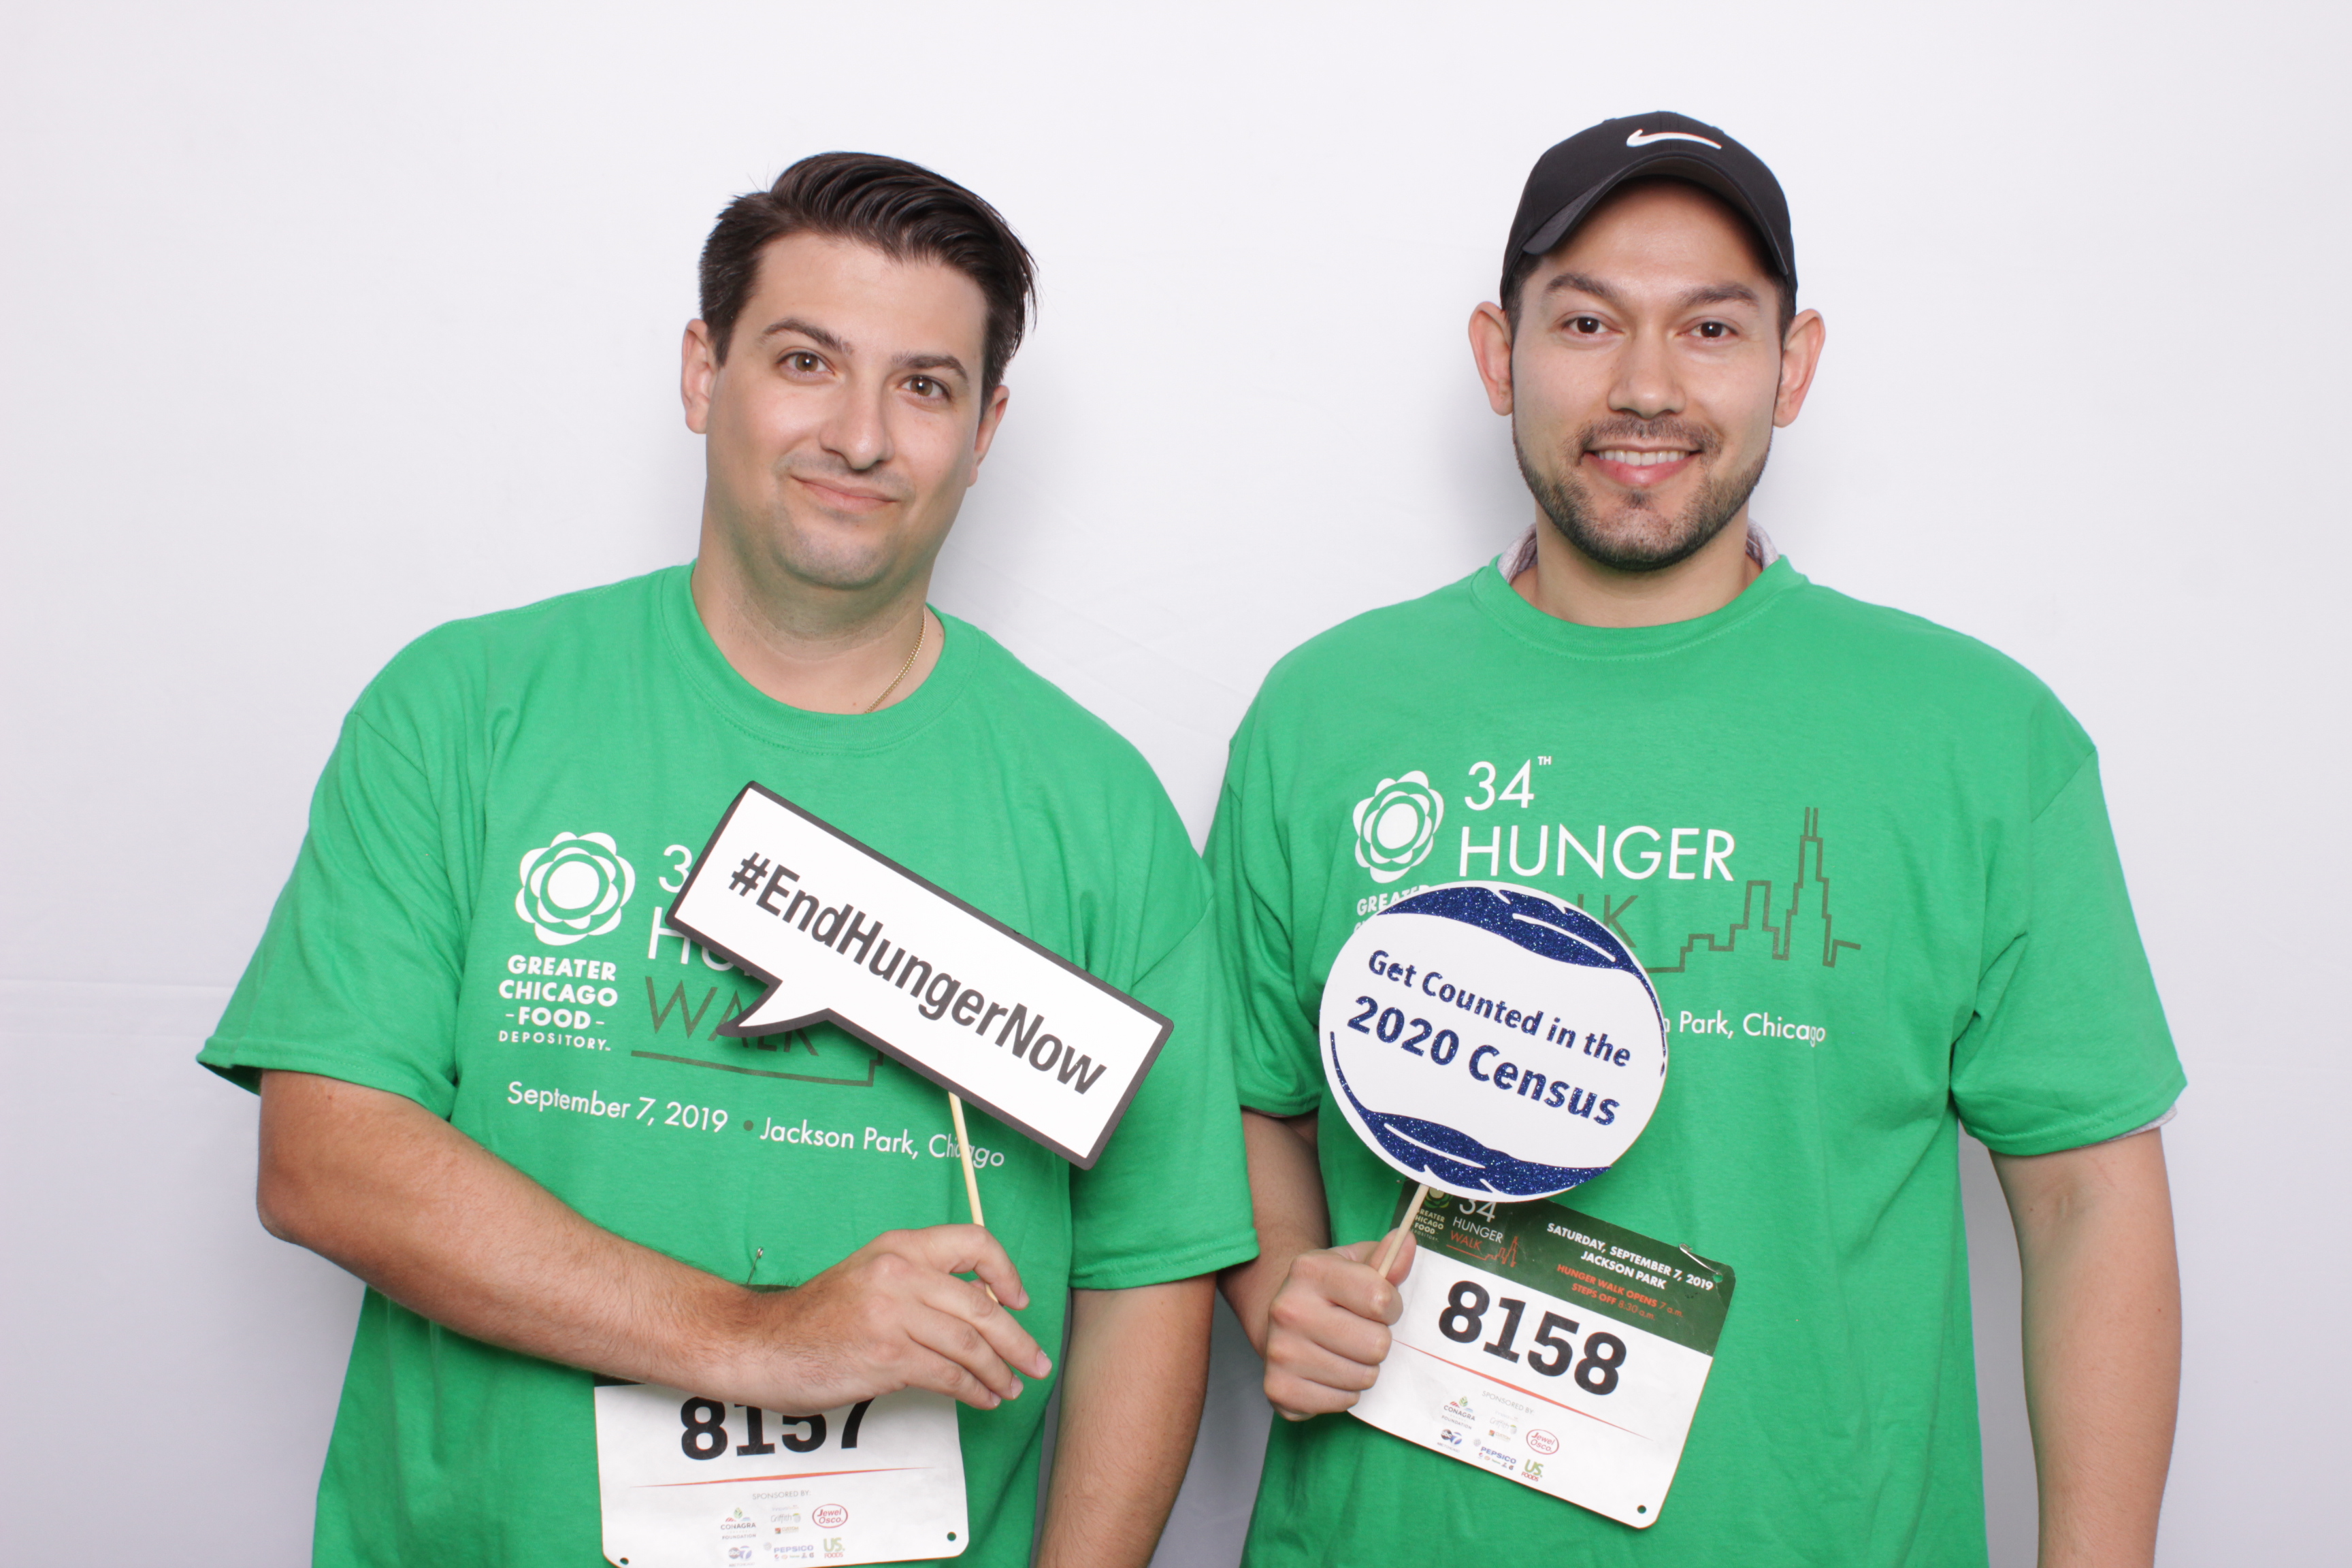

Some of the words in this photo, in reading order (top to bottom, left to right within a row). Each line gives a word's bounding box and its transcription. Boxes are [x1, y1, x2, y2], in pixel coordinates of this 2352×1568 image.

[1459, 822, 1735, 881] HUNGER
[508, 955, 617, 981] GREATER
[729, 851, 1107, 1095] #EndHungerNow
[498, 979, 618, 1007] CHICAGO
[1368, 949, 1417, 987] Get
[1422, 971, 1544, 1036] Counted
[1546, 1017, 1577, 1049] in
[1582, 1033, 1631, 1067] the
[1679, 1009, 1734, 1039] Park,
[1742, 1012, 1826, 1047] Chicago
[1347, 996, 1460, 1065] 2020
[1469, 1045, 1621, 1126] Census
[508, 1081, 631, 1117] September
[636, 1096, 656, 1126] 7,
[664, 1101, 728, 1132] 2019
[760, 1117, 854, 1149] Jackson
[863, 1127, 918, 1160] Park,
[1415, 1215, 1444, 1230] HICAGO
[1417, 1209, 1446, 1223] REATER
[1450, 1230, 1483, 1250] WALK
[1452, 1217, 1503, 1243] HUNGER
[1547, 1223, 1606, 1253] SATURDAY,
[1610, 1246, 1672, 1276] SEPTEMBER
[1672, 1269, 1683, 1281] 7,
[1686, 1274, 1714, 1290] 2019
[1581, 1251, 1635, 1277] JACKSON
[1635, 1270, 1667, 1290] PARK
[1557, 1264, 1596, 1284] HUNGER
[1598, 1279, 1625, 1295] WALK
[1626, 1290, 1659, 1307] OPENS
[1667, 1307, 1684, 1318] a.m.
[1571, 1283, 1598, 1299] STEPS
[1599, 1293, 1618, 1305] OFF
[1618, 1300, 1639, 1314] 8:30
[1639, 1309, 1656, 1321] a.m.
[1438, 1280, 1627, 1396] 8158
[1443, 1405, 1475, 1421] CONAGRA
[1482, 1390, 1524, 1411] SPONSORED
[1441, 1415, 1472, 1430] FOUNDATION
[1531, 1432, 1555, 1446] Jewel
[1480, 1446, 1516, 1465] PEPSICO
[1521, 1471, 1539, 1482] FOODS
[752, 1490, 799, 1500] SPONSORED
[817, 1508, 842, 1517] Jewel
[721, 1522, 757, 1530] CONAGRA
[774, 1544, 814, 1553] PEPSICO
